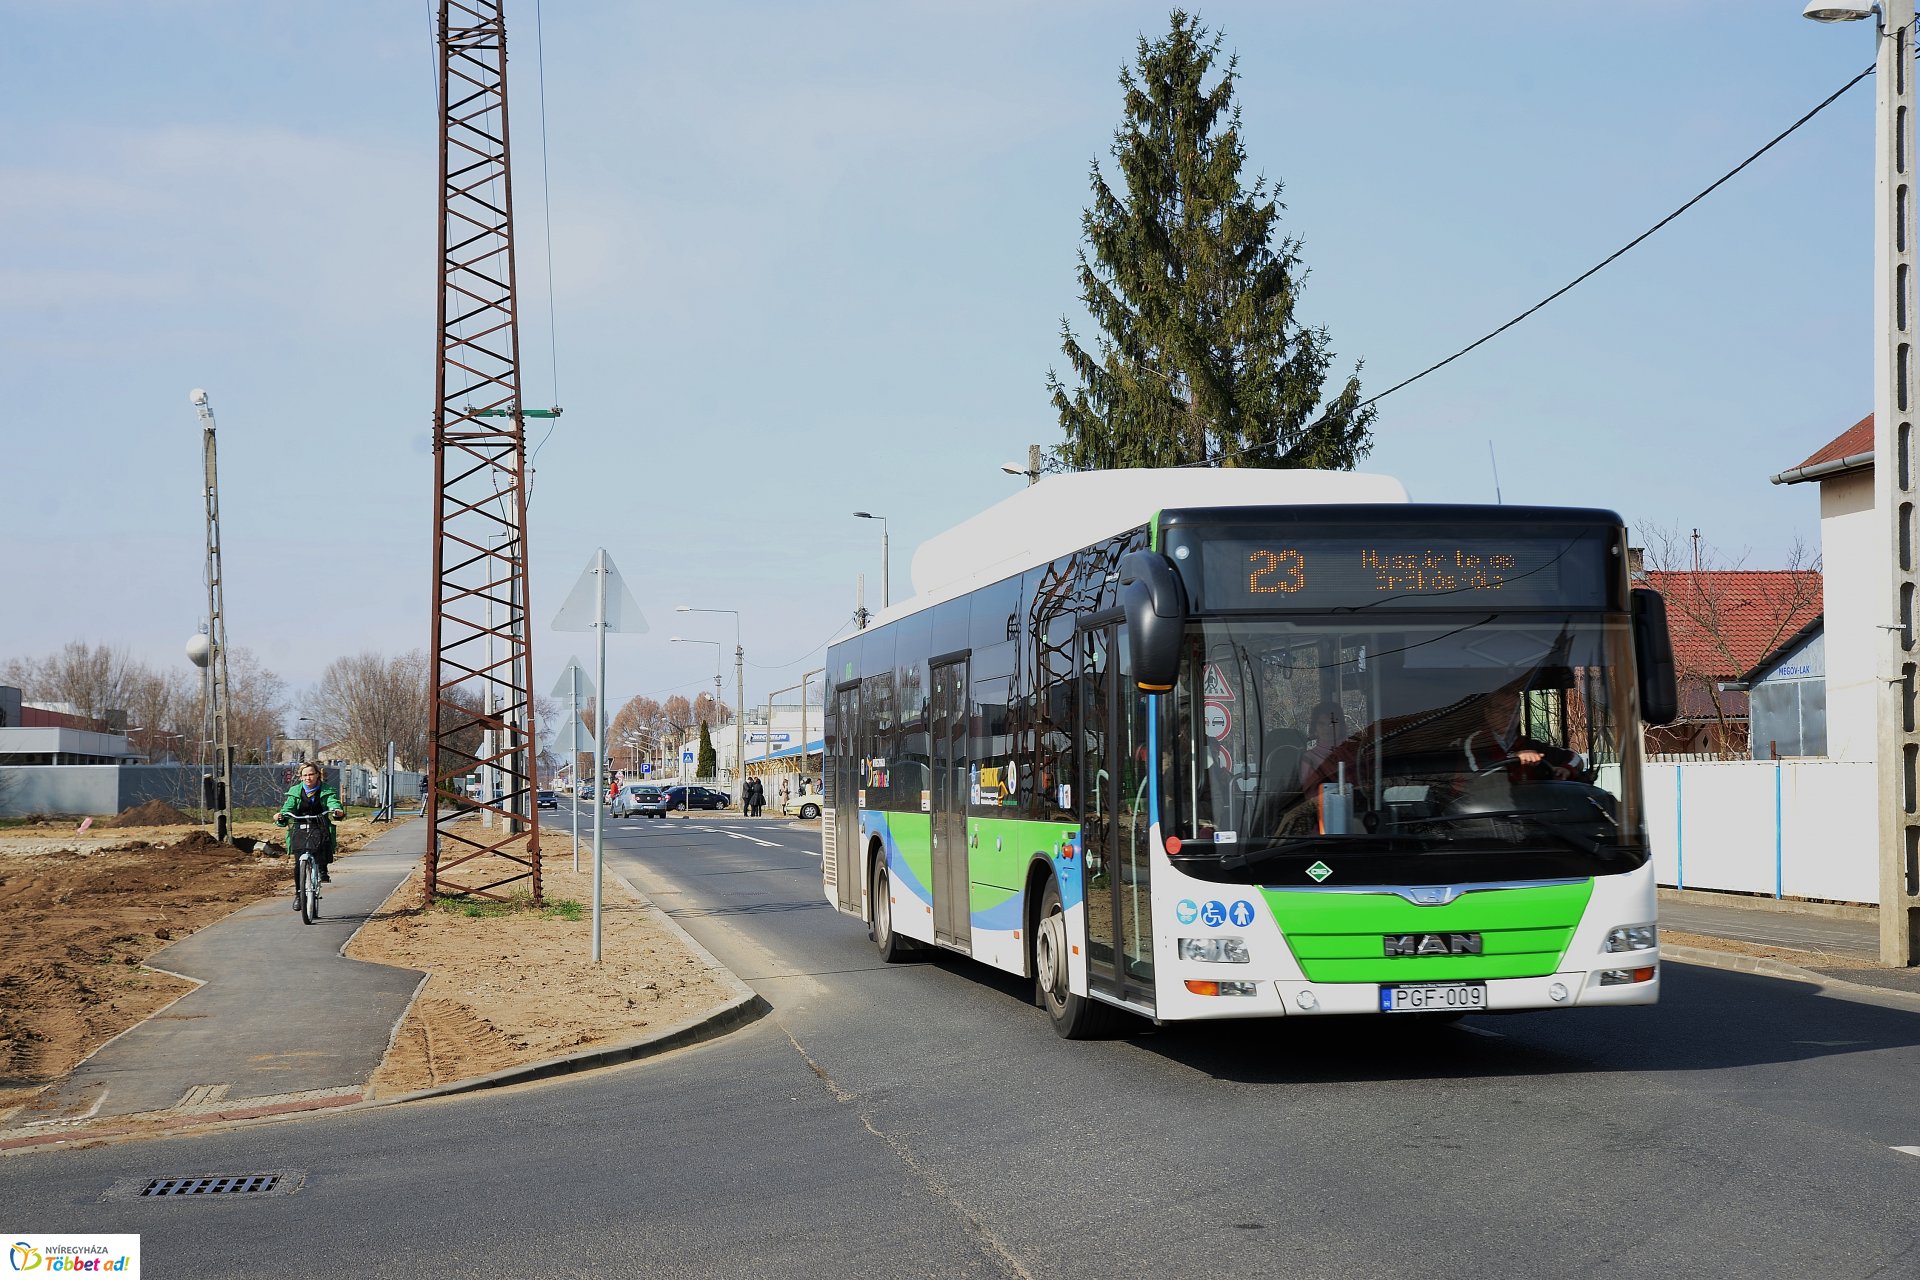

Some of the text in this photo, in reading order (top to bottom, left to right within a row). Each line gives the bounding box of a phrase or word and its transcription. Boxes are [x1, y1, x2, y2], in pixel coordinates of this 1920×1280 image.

[1454, 549, 1515, 571] teep
[1249, 550, 1305, 593] 23
[643, 764, 650, 772] P
[1384, 934, 1482, 956] MAN
[1396, 987, 1480, 1008] PGF-009
